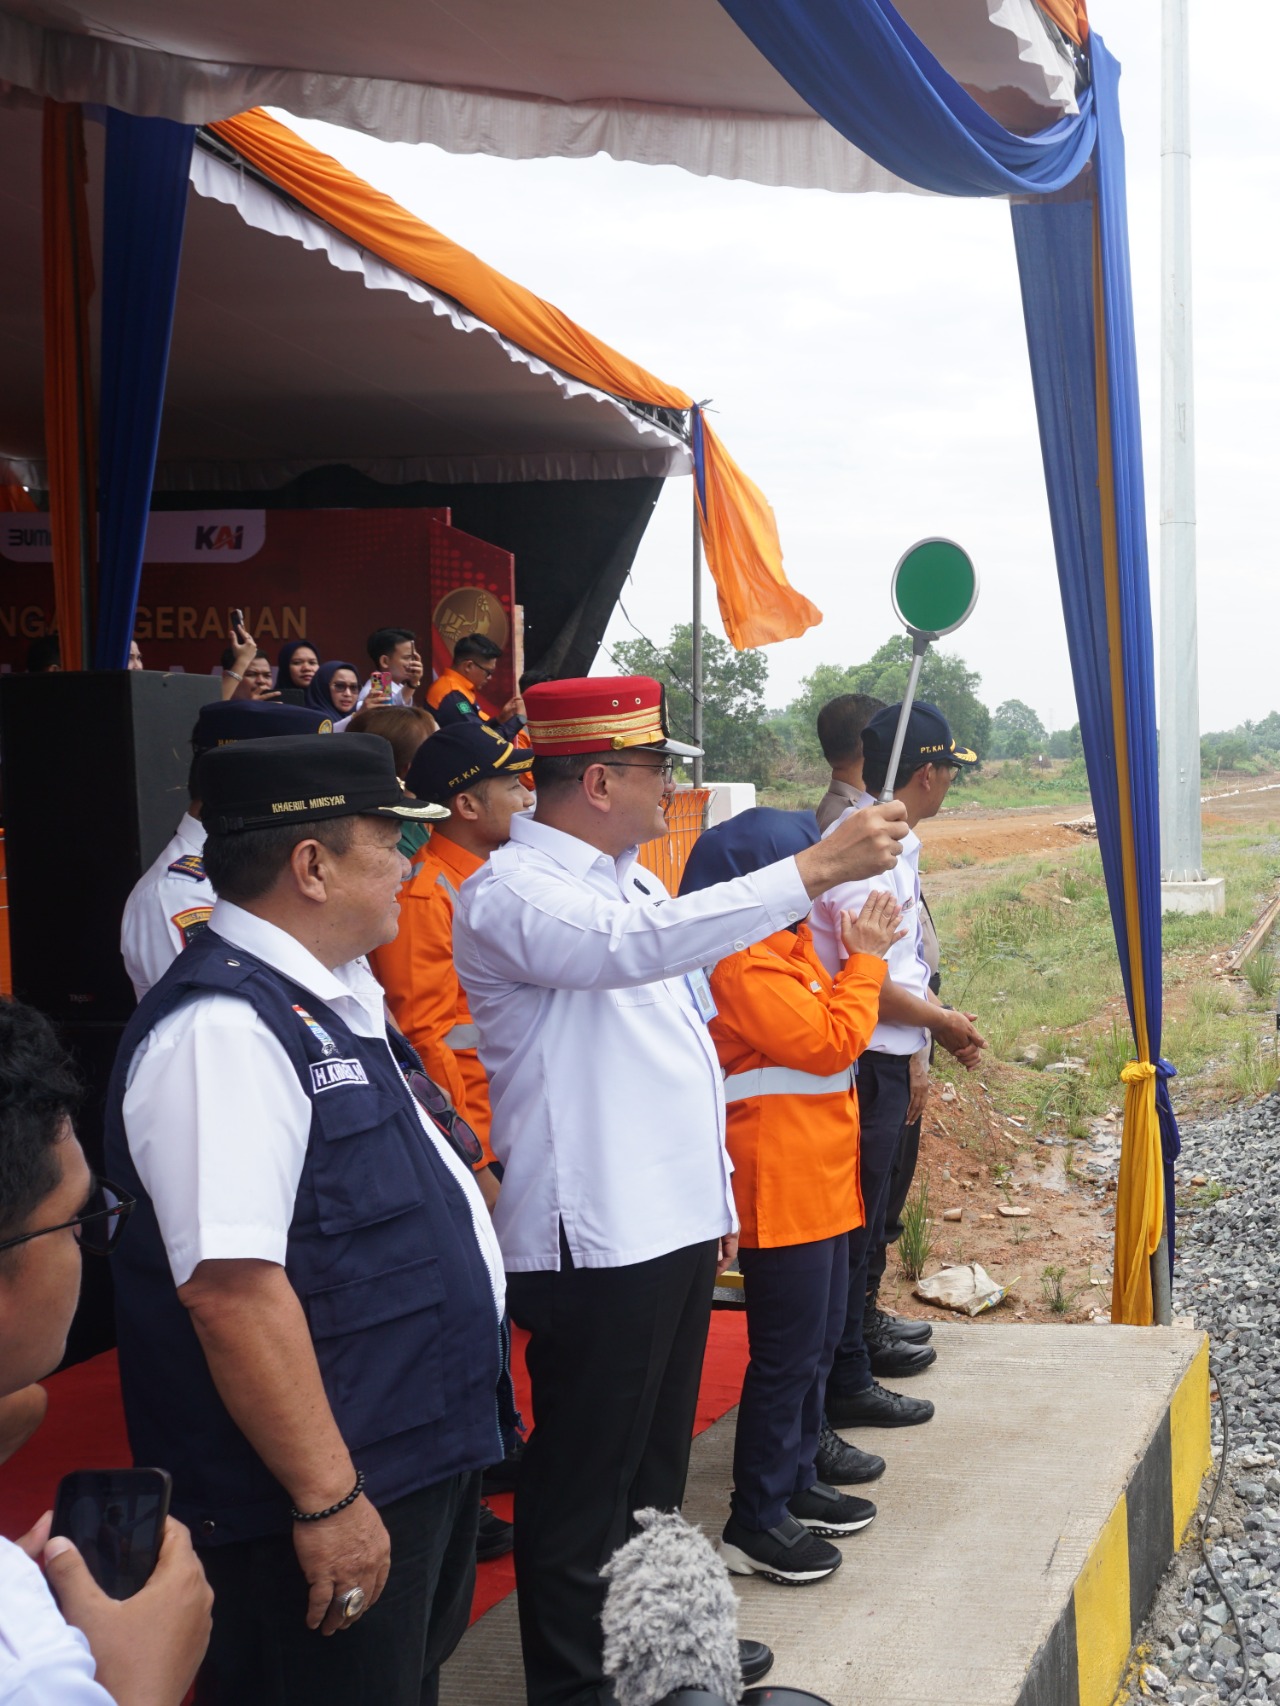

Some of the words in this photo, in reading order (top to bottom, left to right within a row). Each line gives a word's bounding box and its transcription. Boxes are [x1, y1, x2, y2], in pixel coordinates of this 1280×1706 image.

[195, 525, 244, 550] KAI
[932, 744, 944, 752] KAI
[462, 765, 480, 779] KAI
[309, 795, 346, 809] MINSYAR
